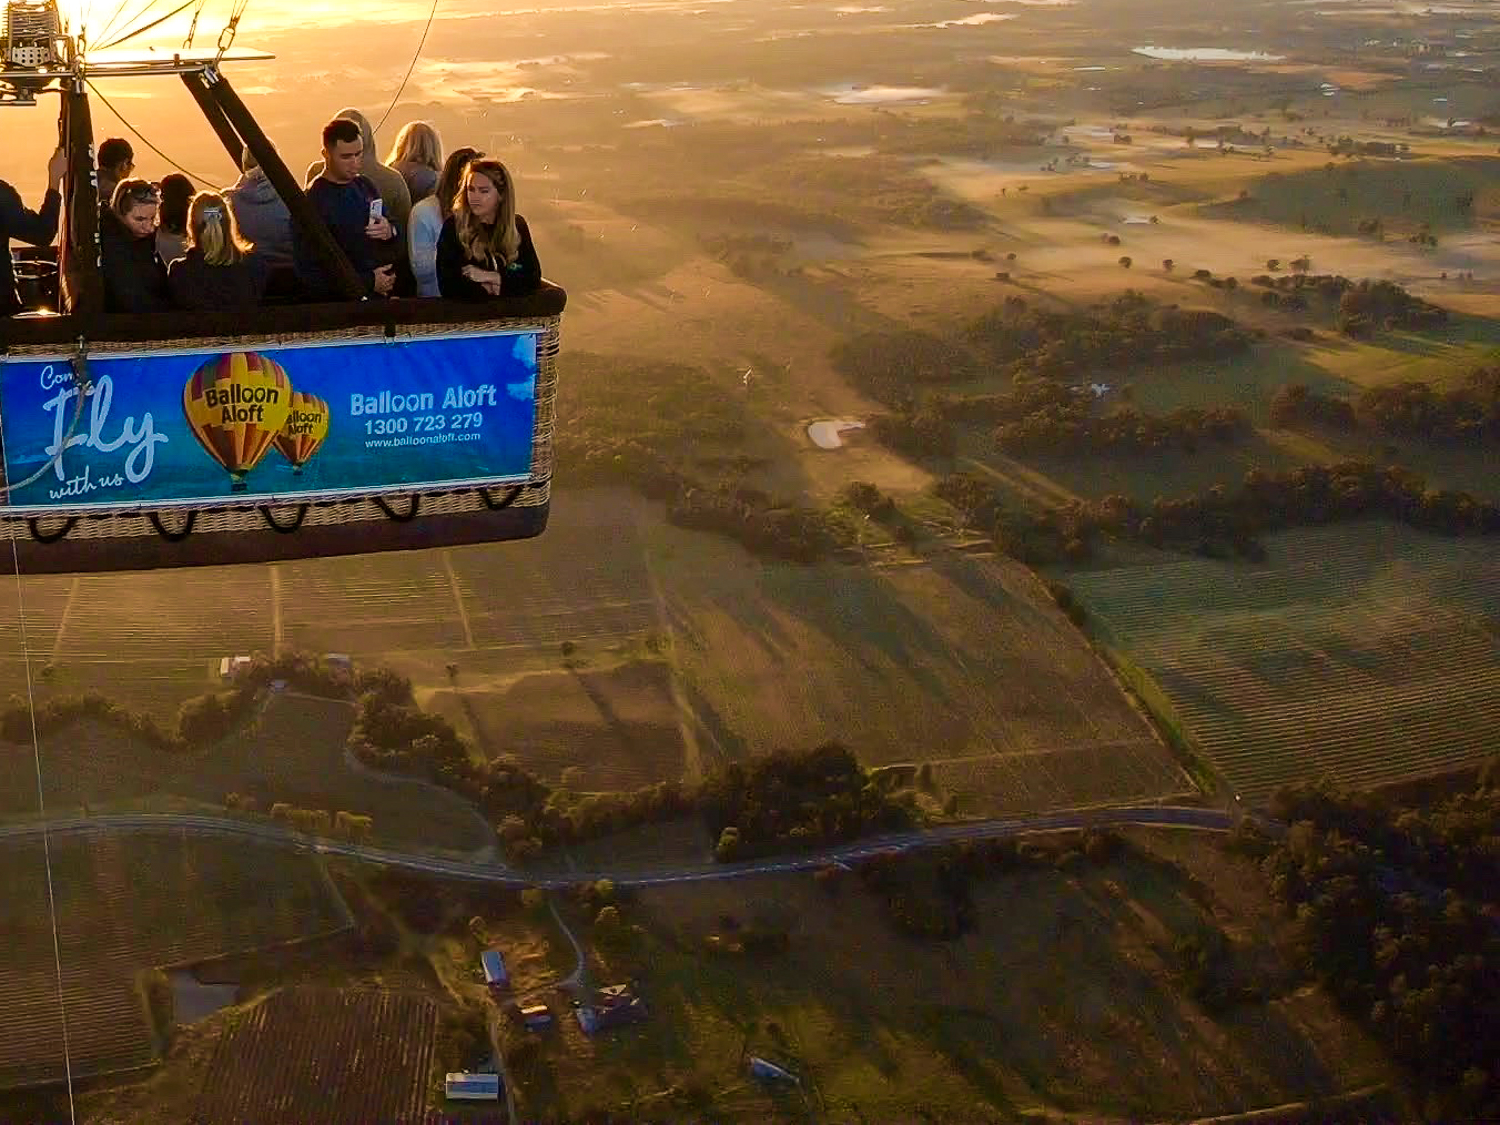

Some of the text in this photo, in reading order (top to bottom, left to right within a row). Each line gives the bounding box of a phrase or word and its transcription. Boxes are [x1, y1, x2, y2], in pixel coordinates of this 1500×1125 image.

[205, 384, 279, 408] Balloon
[350, 384, 497, 415] Balloon Aloft
[221, 404, 264, 423] Aloft
[286, 411, 322, 424] alloon
[365, 412, 483, 435] 1300 723 279
[43, 375, 169, 483] Fly
[365, 432, 481, 448] www.balloonaloft.com
[49, 464, 125, 499] with us
